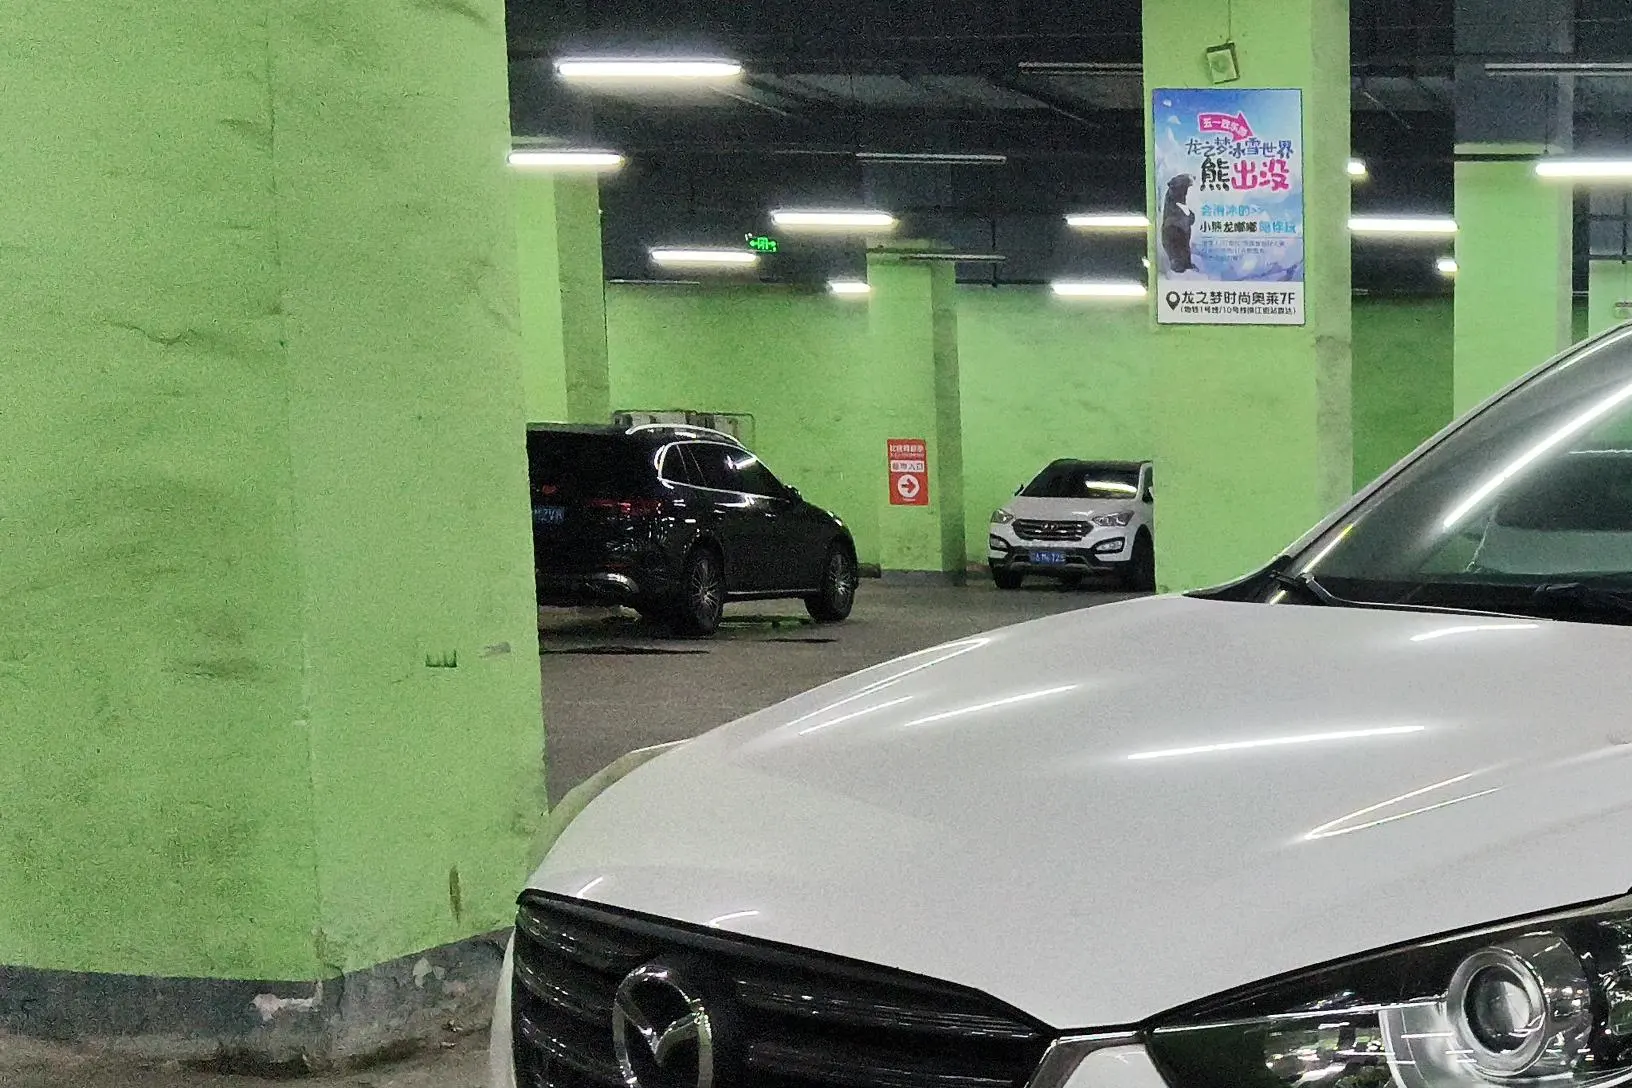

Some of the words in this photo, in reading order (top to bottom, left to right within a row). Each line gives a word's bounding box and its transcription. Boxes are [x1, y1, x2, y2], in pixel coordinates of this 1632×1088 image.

[1185, 137, 1294, 159] 龙之梦冰雪世界
[1200, 157, 1290, 192] 熊出没
[1181, 290, 1295, 305] 龙之梦时尚奥莱7F
